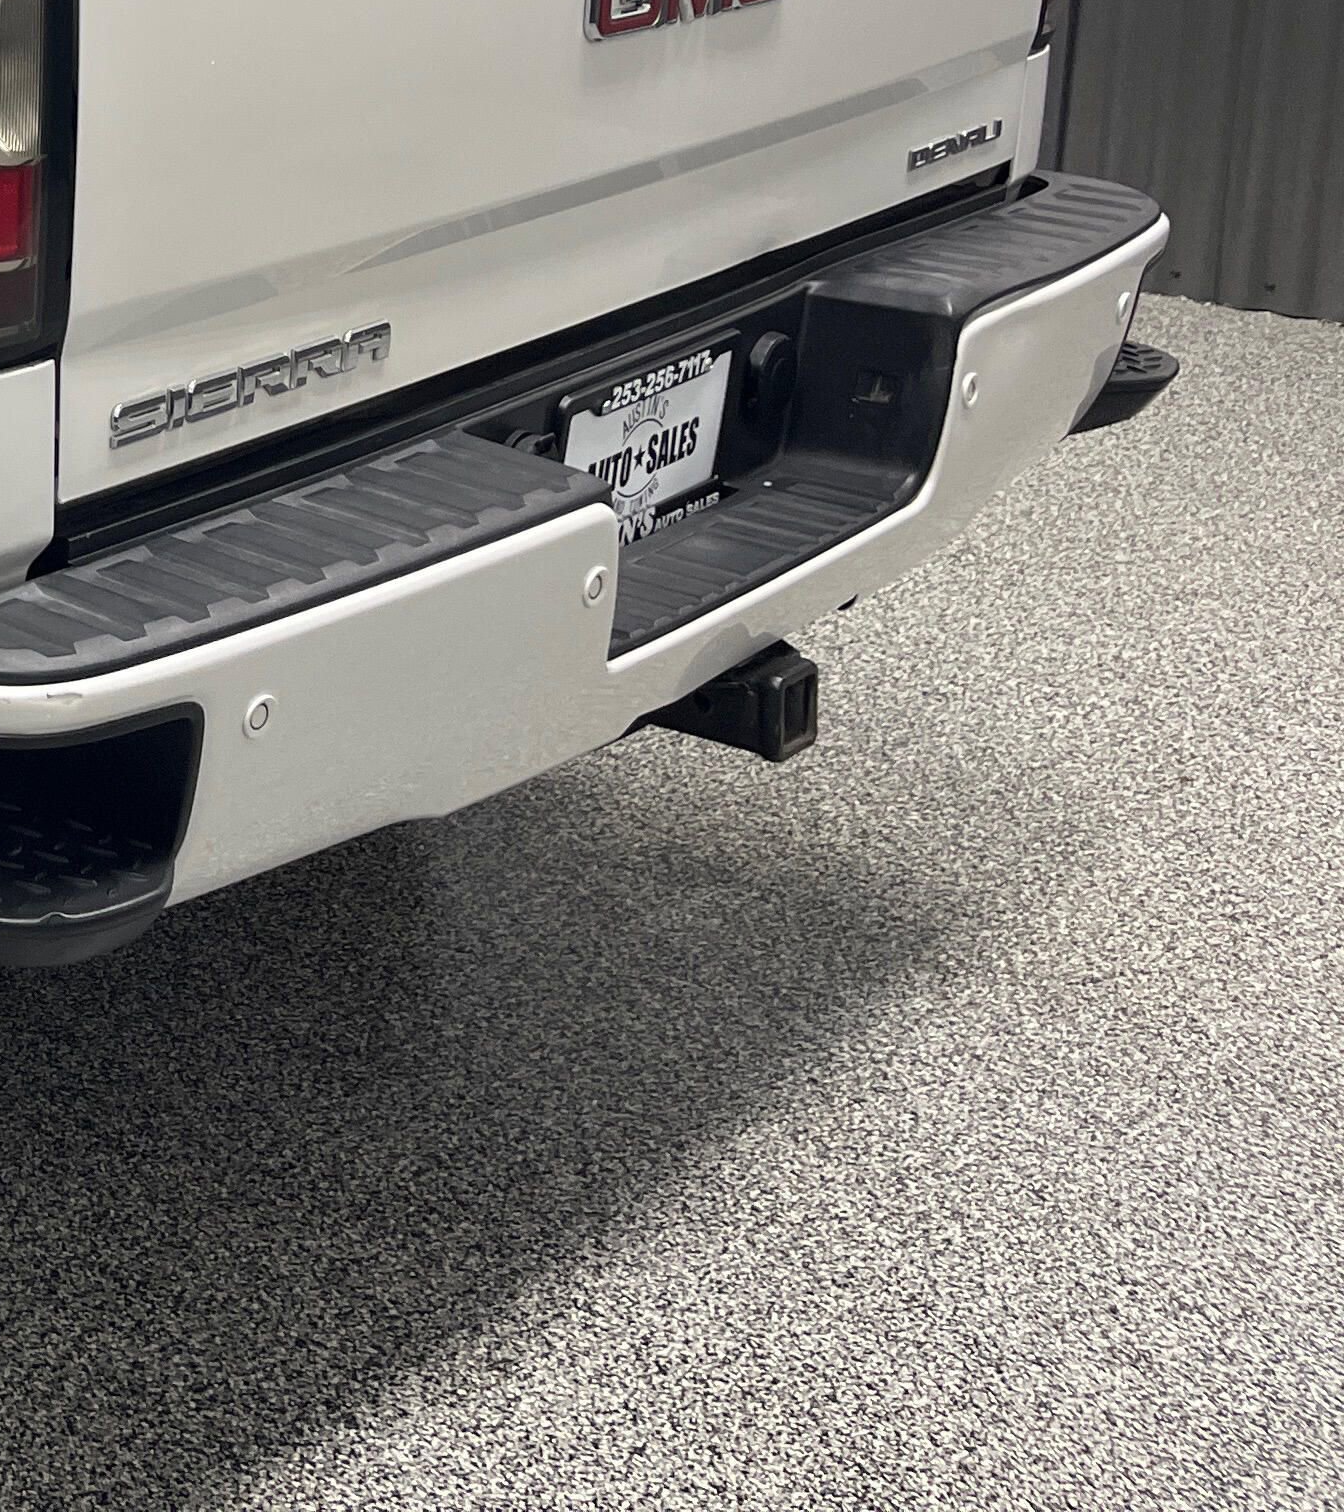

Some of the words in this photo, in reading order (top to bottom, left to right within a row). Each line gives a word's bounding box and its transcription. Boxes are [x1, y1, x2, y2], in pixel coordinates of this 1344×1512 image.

[906, 118, 1003, 172] DENALI
[109, 318, 392, 450] SIERRA
[611, 349, 711, 408] 253-256-7117
[646, 416, 700, 474] SALES
[653, 508, 685, 532] AUTO
[686, 491, 720, 516] SALES
